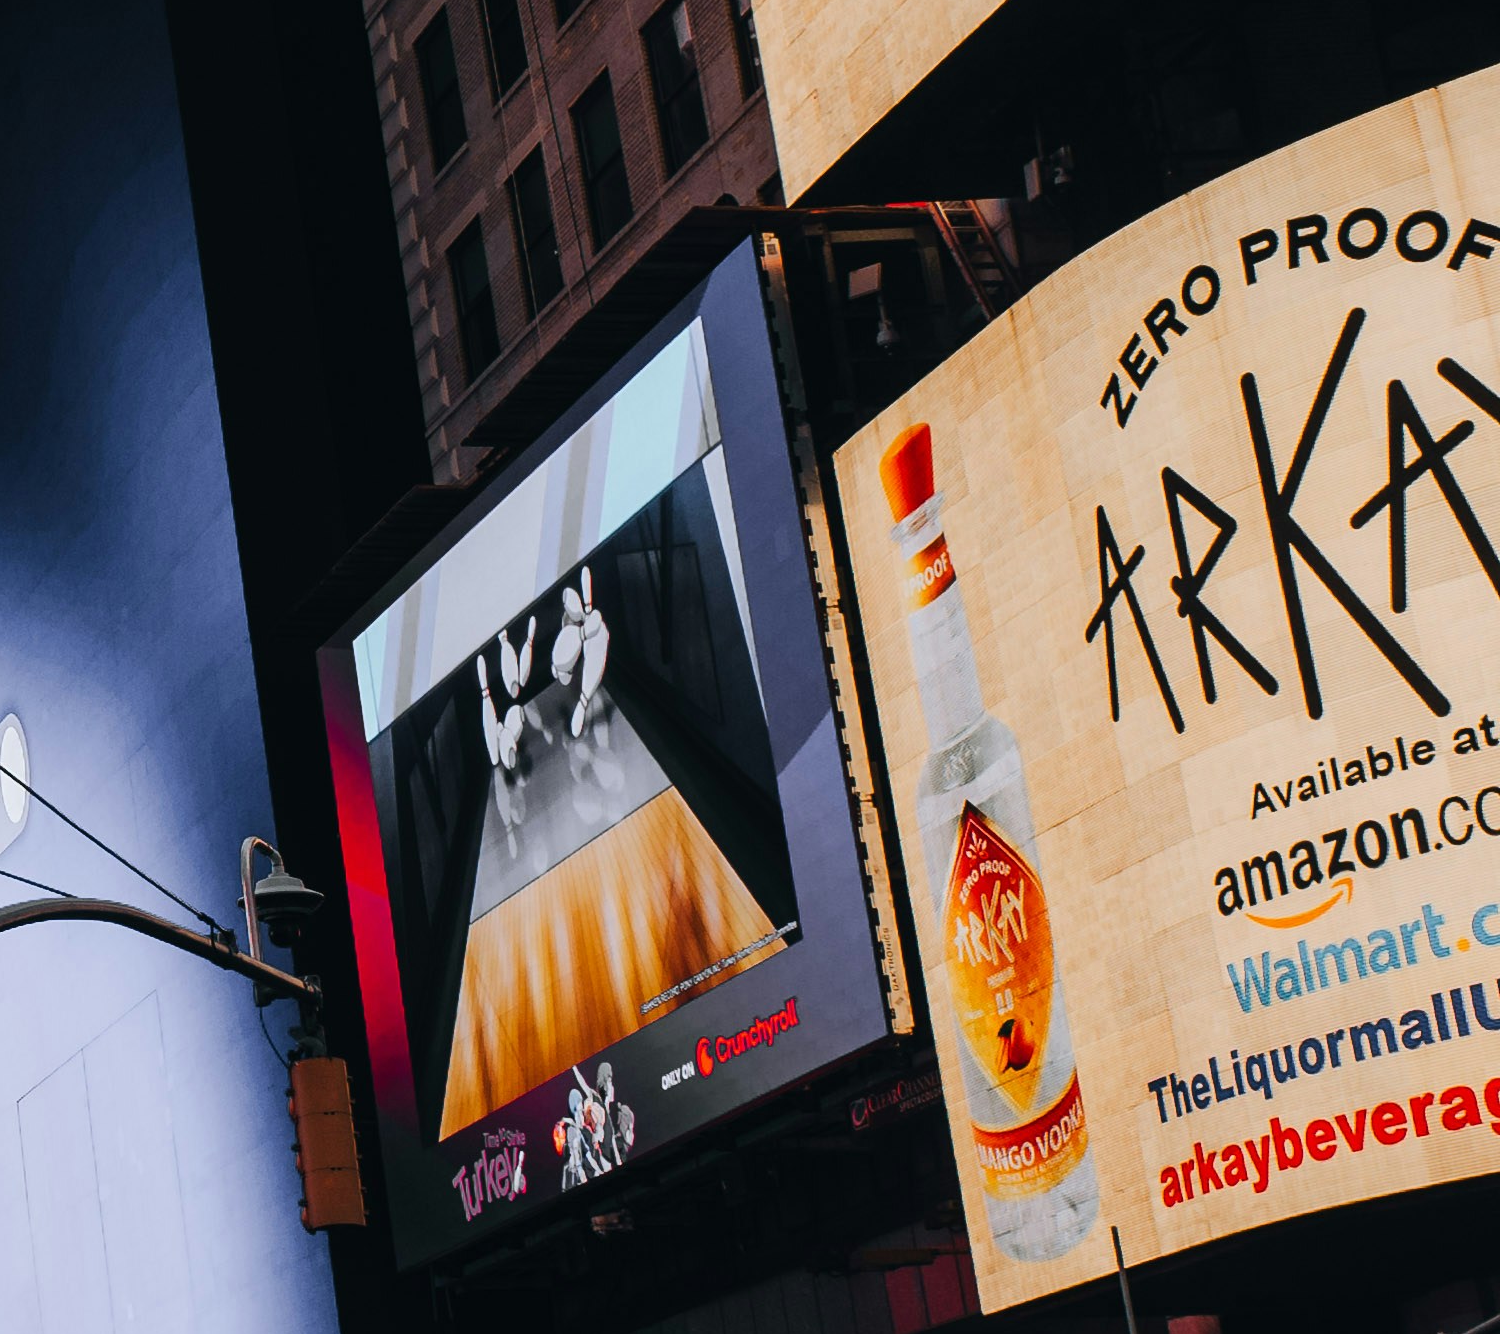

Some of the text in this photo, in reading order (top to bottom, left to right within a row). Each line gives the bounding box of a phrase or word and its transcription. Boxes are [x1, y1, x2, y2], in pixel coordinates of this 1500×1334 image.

[1100, 264, 1221, 429] ZERO
[1250, 713, 1496, 819] Available at
[883, 927, 899, 993] DAKTRONICS
[955, 879, 1026, 968] ARKAY
[715, 997, 799, 1064] Crunchyroll
[661, 1063, 696, 1092] ONLY ON
[976, 1097, 1084, 1172] MANGO VODKA
